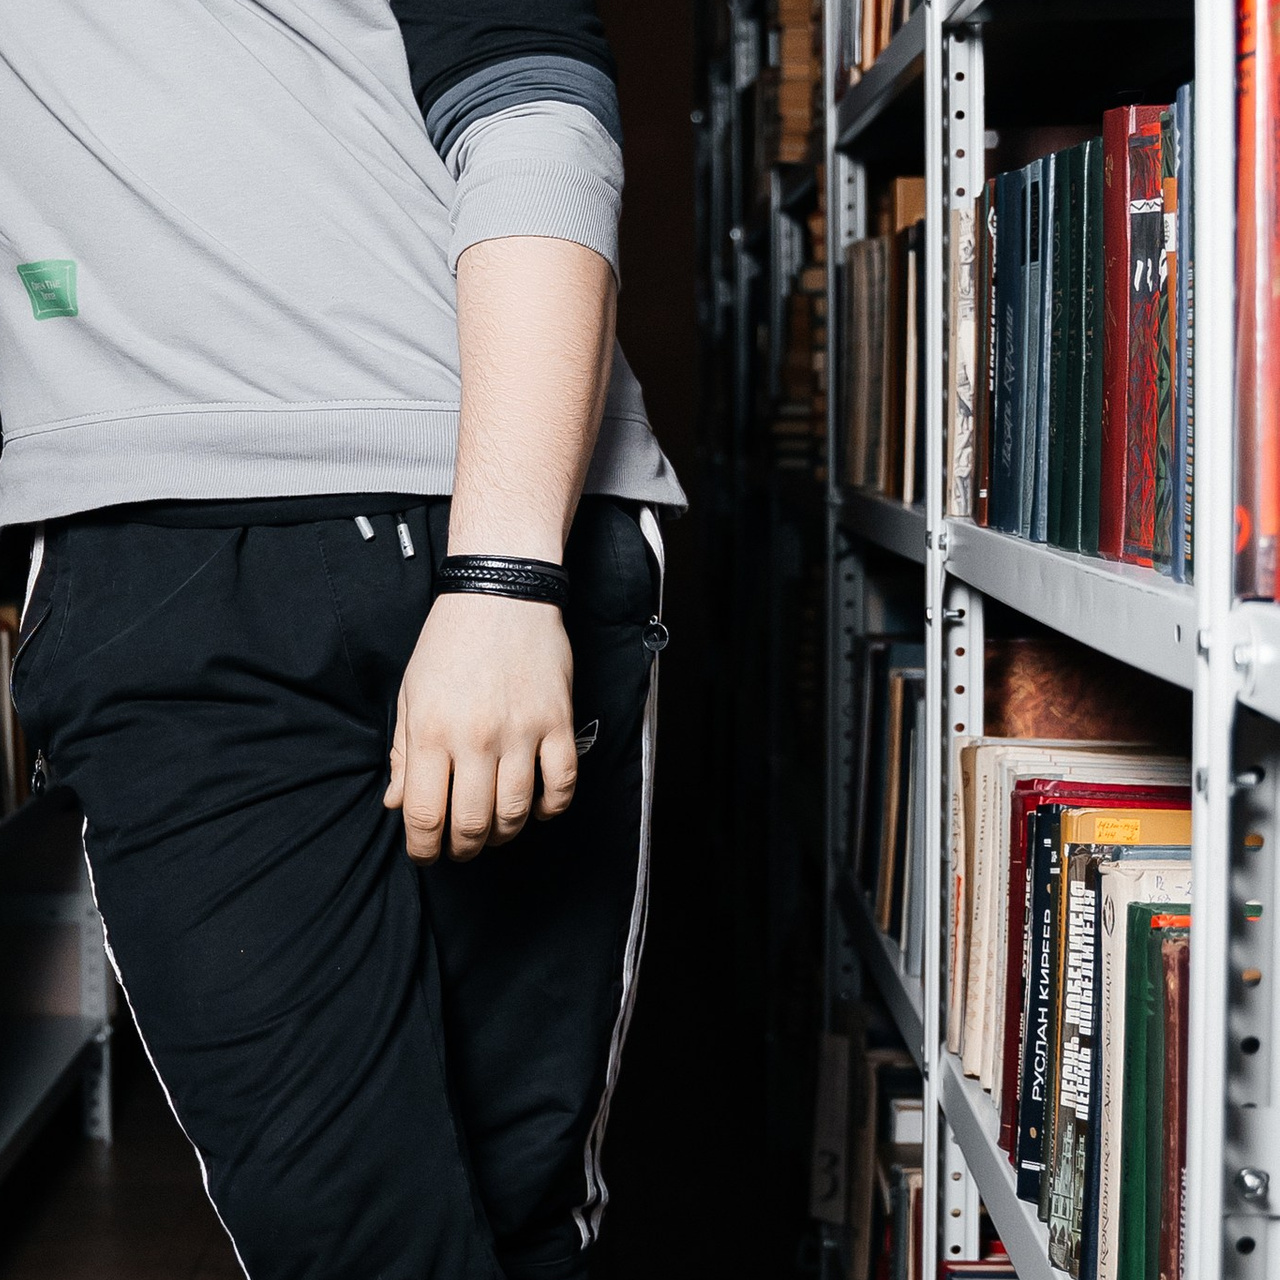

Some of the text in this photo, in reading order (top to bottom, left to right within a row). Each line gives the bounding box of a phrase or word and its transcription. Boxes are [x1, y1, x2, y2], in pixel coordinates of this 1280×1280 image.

[1031, 1007, 1048, 1102] РУСЛАН
[1060, 879, 1086, 1109] ПЕСНЬ ПОБЕДИТЕЛЯ
[1075, 888, 1096, 1121] ПЕСНЬ ПОБЕДИТЕЛЯ
[1098, 1130, 1111, 1267] КОЖЕВНИКОВ
